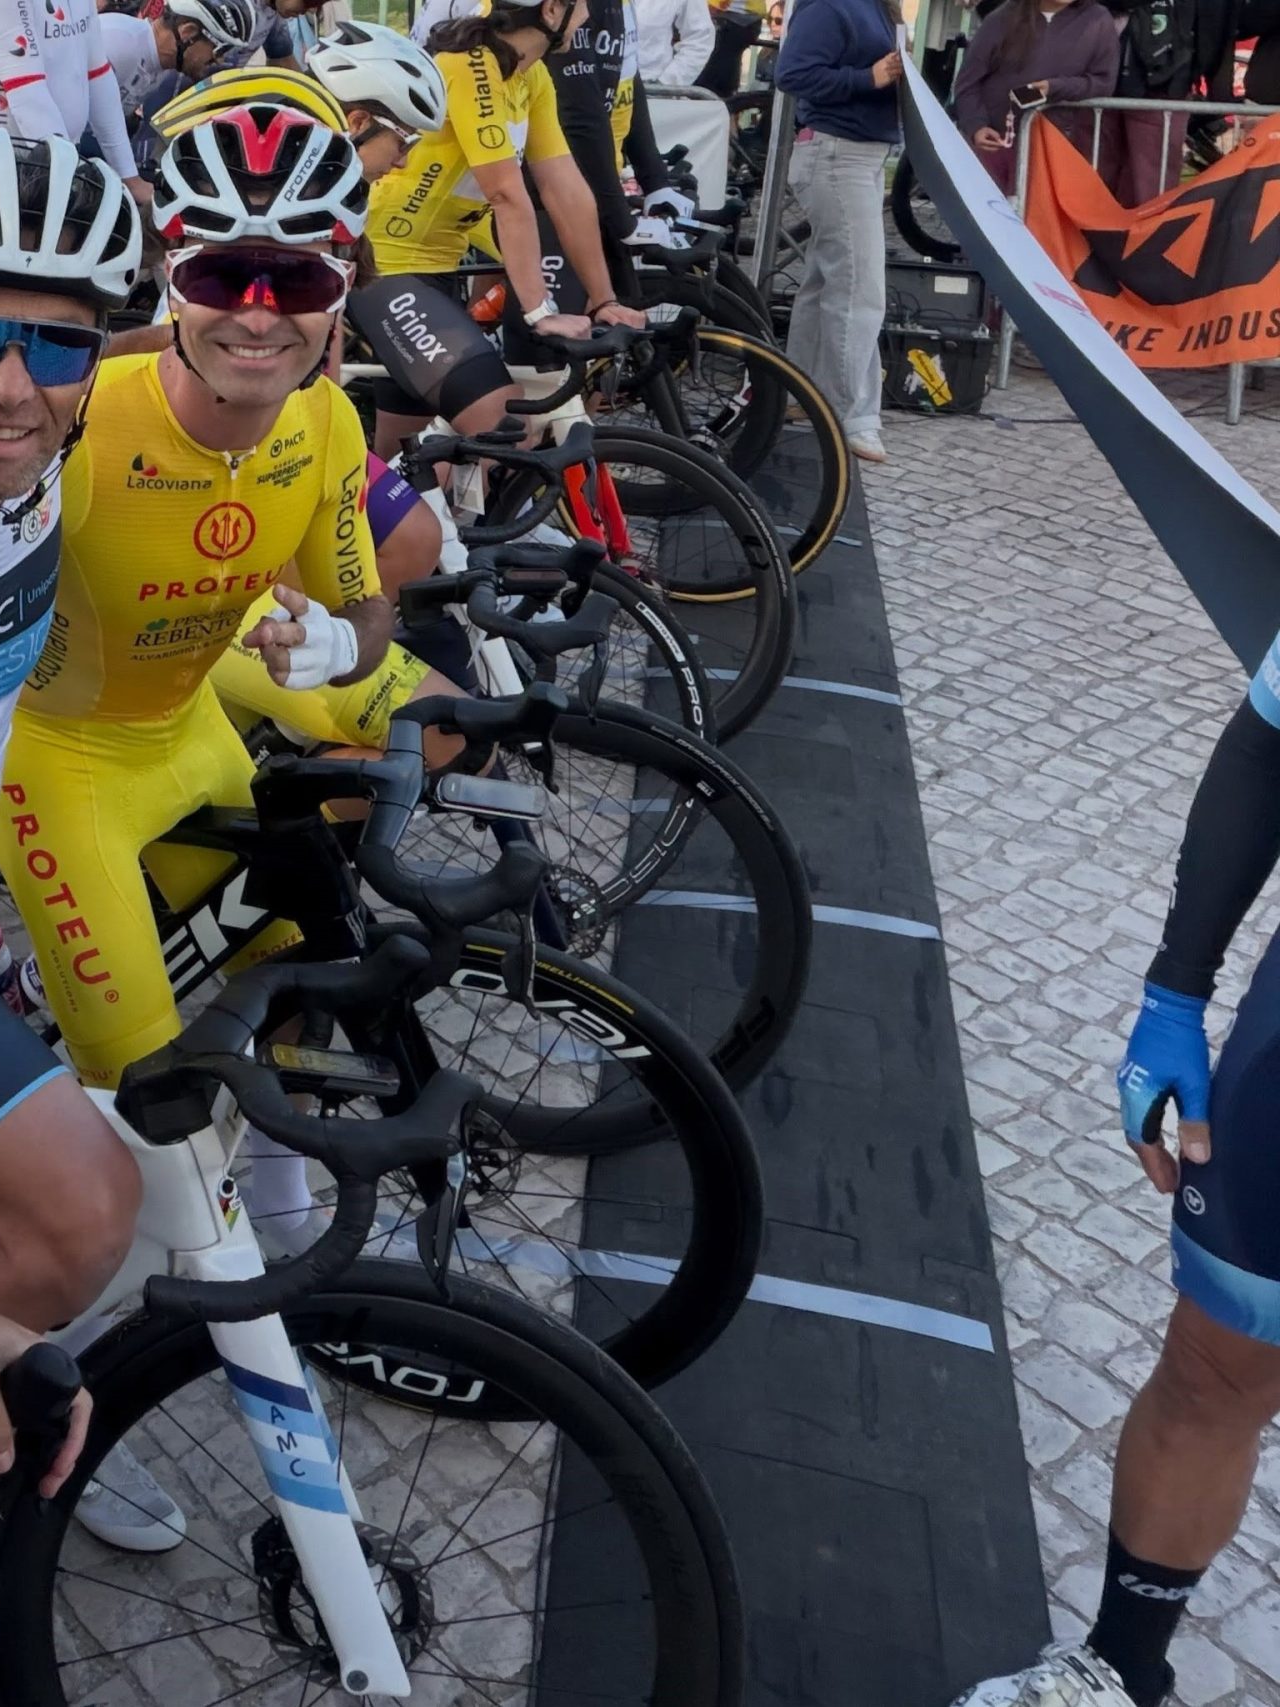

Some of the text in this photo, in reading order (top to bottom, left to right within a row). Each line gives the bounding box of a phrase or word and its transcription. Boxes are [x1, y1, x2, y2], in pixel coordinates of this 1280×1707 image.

[19, 1, 39, 57] Lacovian
[44, 16, 91, 39] Lacovia
[470, 46, 495, 119] triauto
[402, 161, 443, 215] triauto
[1101, 319, 1163, 352] IKE
[126, 474, 213, 492] Lacoviana
[138, 563, 285, 602] PROTEU
[1, 783, 112, 986] PROTEU
[161, 866, 270, 995] EK
